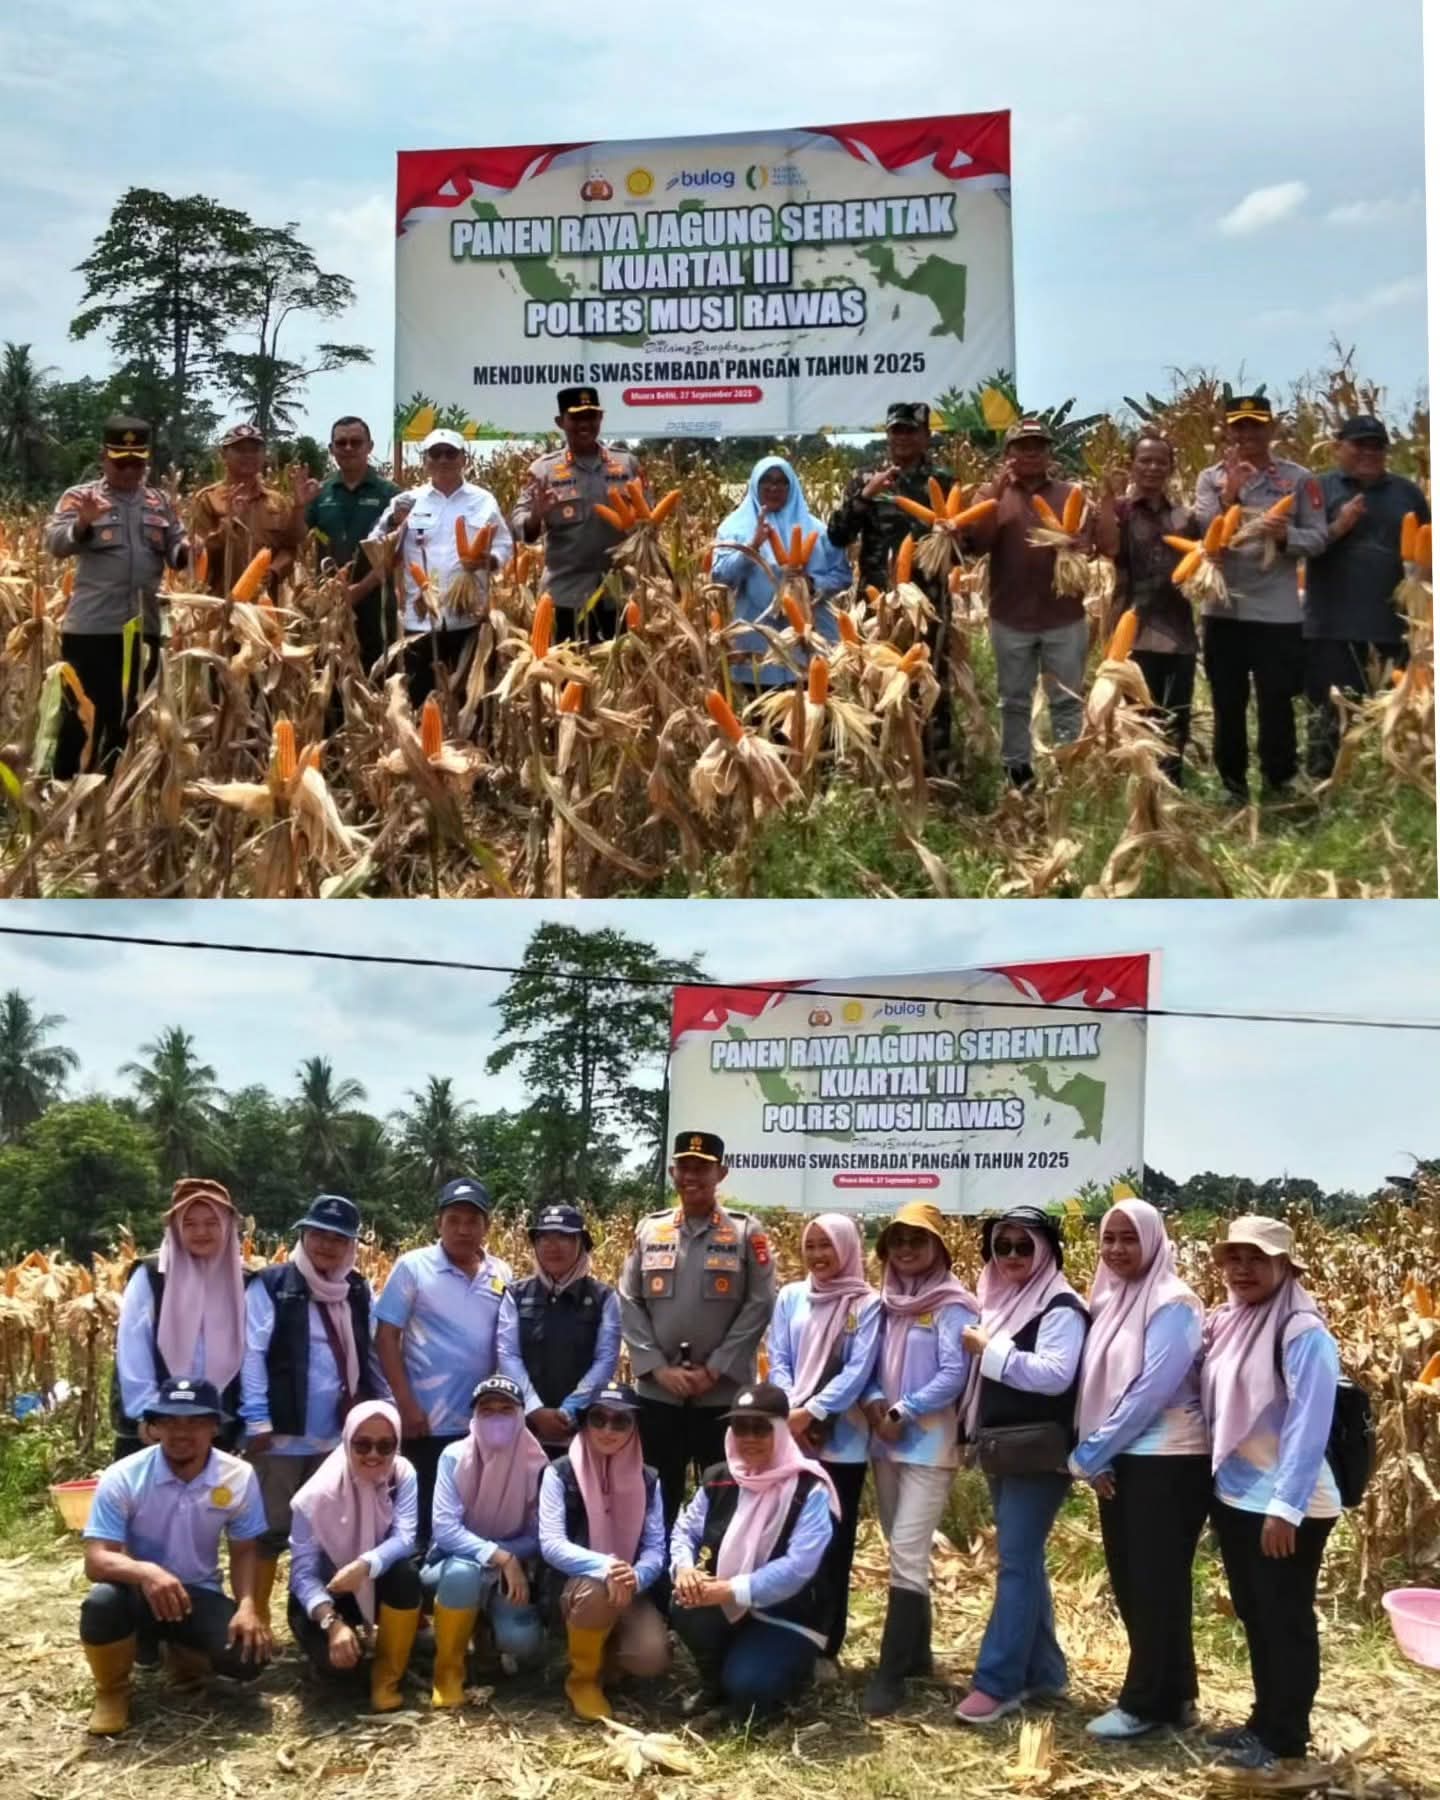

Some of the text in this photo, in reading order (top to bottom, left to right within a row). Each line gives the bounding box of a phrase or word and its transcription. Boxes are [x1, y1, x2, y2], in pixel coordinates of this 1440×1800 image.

[682, 169, 735, 188] bulog
[453, 195, 956, 257] PANEN RAYA JAGUNG SERENTAK
[602, 247, 790, 291] KUARTAL III
[527, 290, 865, 336] POLRES MUSI RAWAS
[473, 352, 926, 385] MENDUKUNG SWASEMBADA PANGAN TAHUN 2025
[691, 389, 732, 400] September
[884, 1002, 926, 1017] bulog
[712, 1025, 1099, 1069] PANEN RAYA JAGUNG SERENTAK
[820, 1065, 965, 1097] KUARTAL III
[764, 1099, 1023, 1131] POLRES MUSI RAWAS
[724, 1151, 1069, 1169] MENDUKUNG SWASEMBADA PANGAN TAHUN 2025
